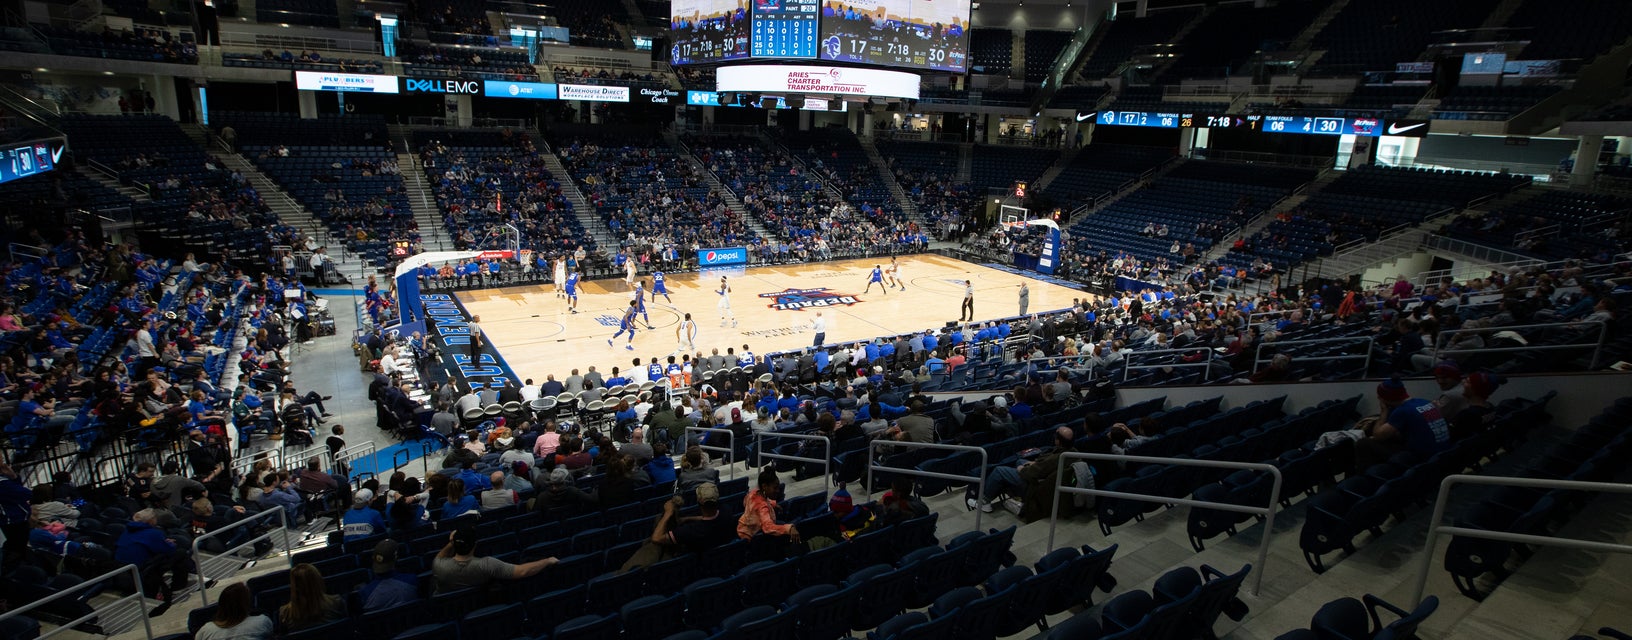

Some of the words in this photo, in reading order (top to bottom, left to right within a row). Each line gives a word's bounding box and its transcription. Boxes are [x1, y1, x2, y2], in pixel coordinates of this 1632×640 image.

[700, 41, 712, 52] 7:18
[724, 38, 734, 51] 30
[851, 40, 867, 53] 17
[888, 43, 909, 55] 7:18
[683, 44, 691, 56] 17
[929, 49, 944, 61] 30
[602, 87, 623, 95] DIRECT
[640, 89, 662, 97] Chicago
[787, 84, 850, 92] TRANSPORTATION
[1125, 114, 1135, 123] 17
[1162, 118, 1172, 126] 06
[1207, 116, 1230, 126] 7:18
[1250, 121, 1255, 129] 1
[1271, 121, 1284, 131] 06
[1303, 122, 1310, 131] 4
[1320, 120, 1337, 131] 30
[20, 152, 31, 170] 30
[12, 159, 18, 175] 4
[718, 252, 738, 261] pepsi
